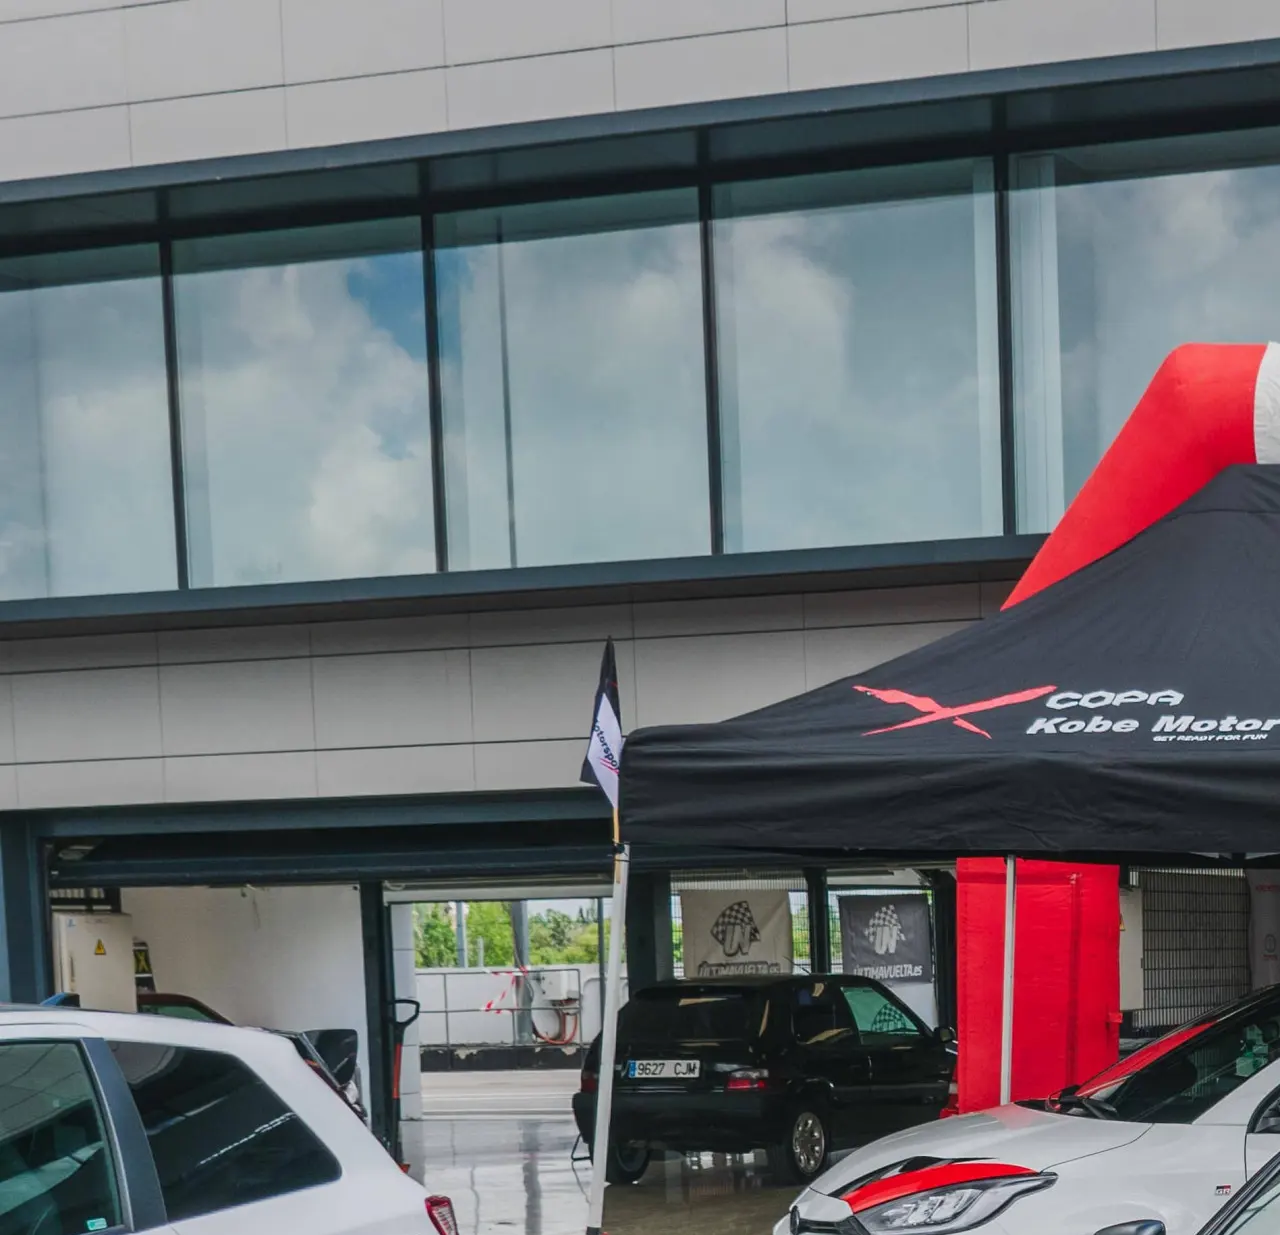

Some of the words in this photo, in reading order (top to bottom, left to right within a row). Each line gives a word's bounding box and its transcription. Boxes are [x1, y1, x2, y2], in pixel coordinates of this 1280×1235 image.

[1046, 689, 1185, 710] COPA
[1025, 716, 1140, 735] Kobe
[1176, 734, 1216, 742] READY
[1241, 733, 1268, 741] FUN
[637, 1062, 665, 1076] 9627
